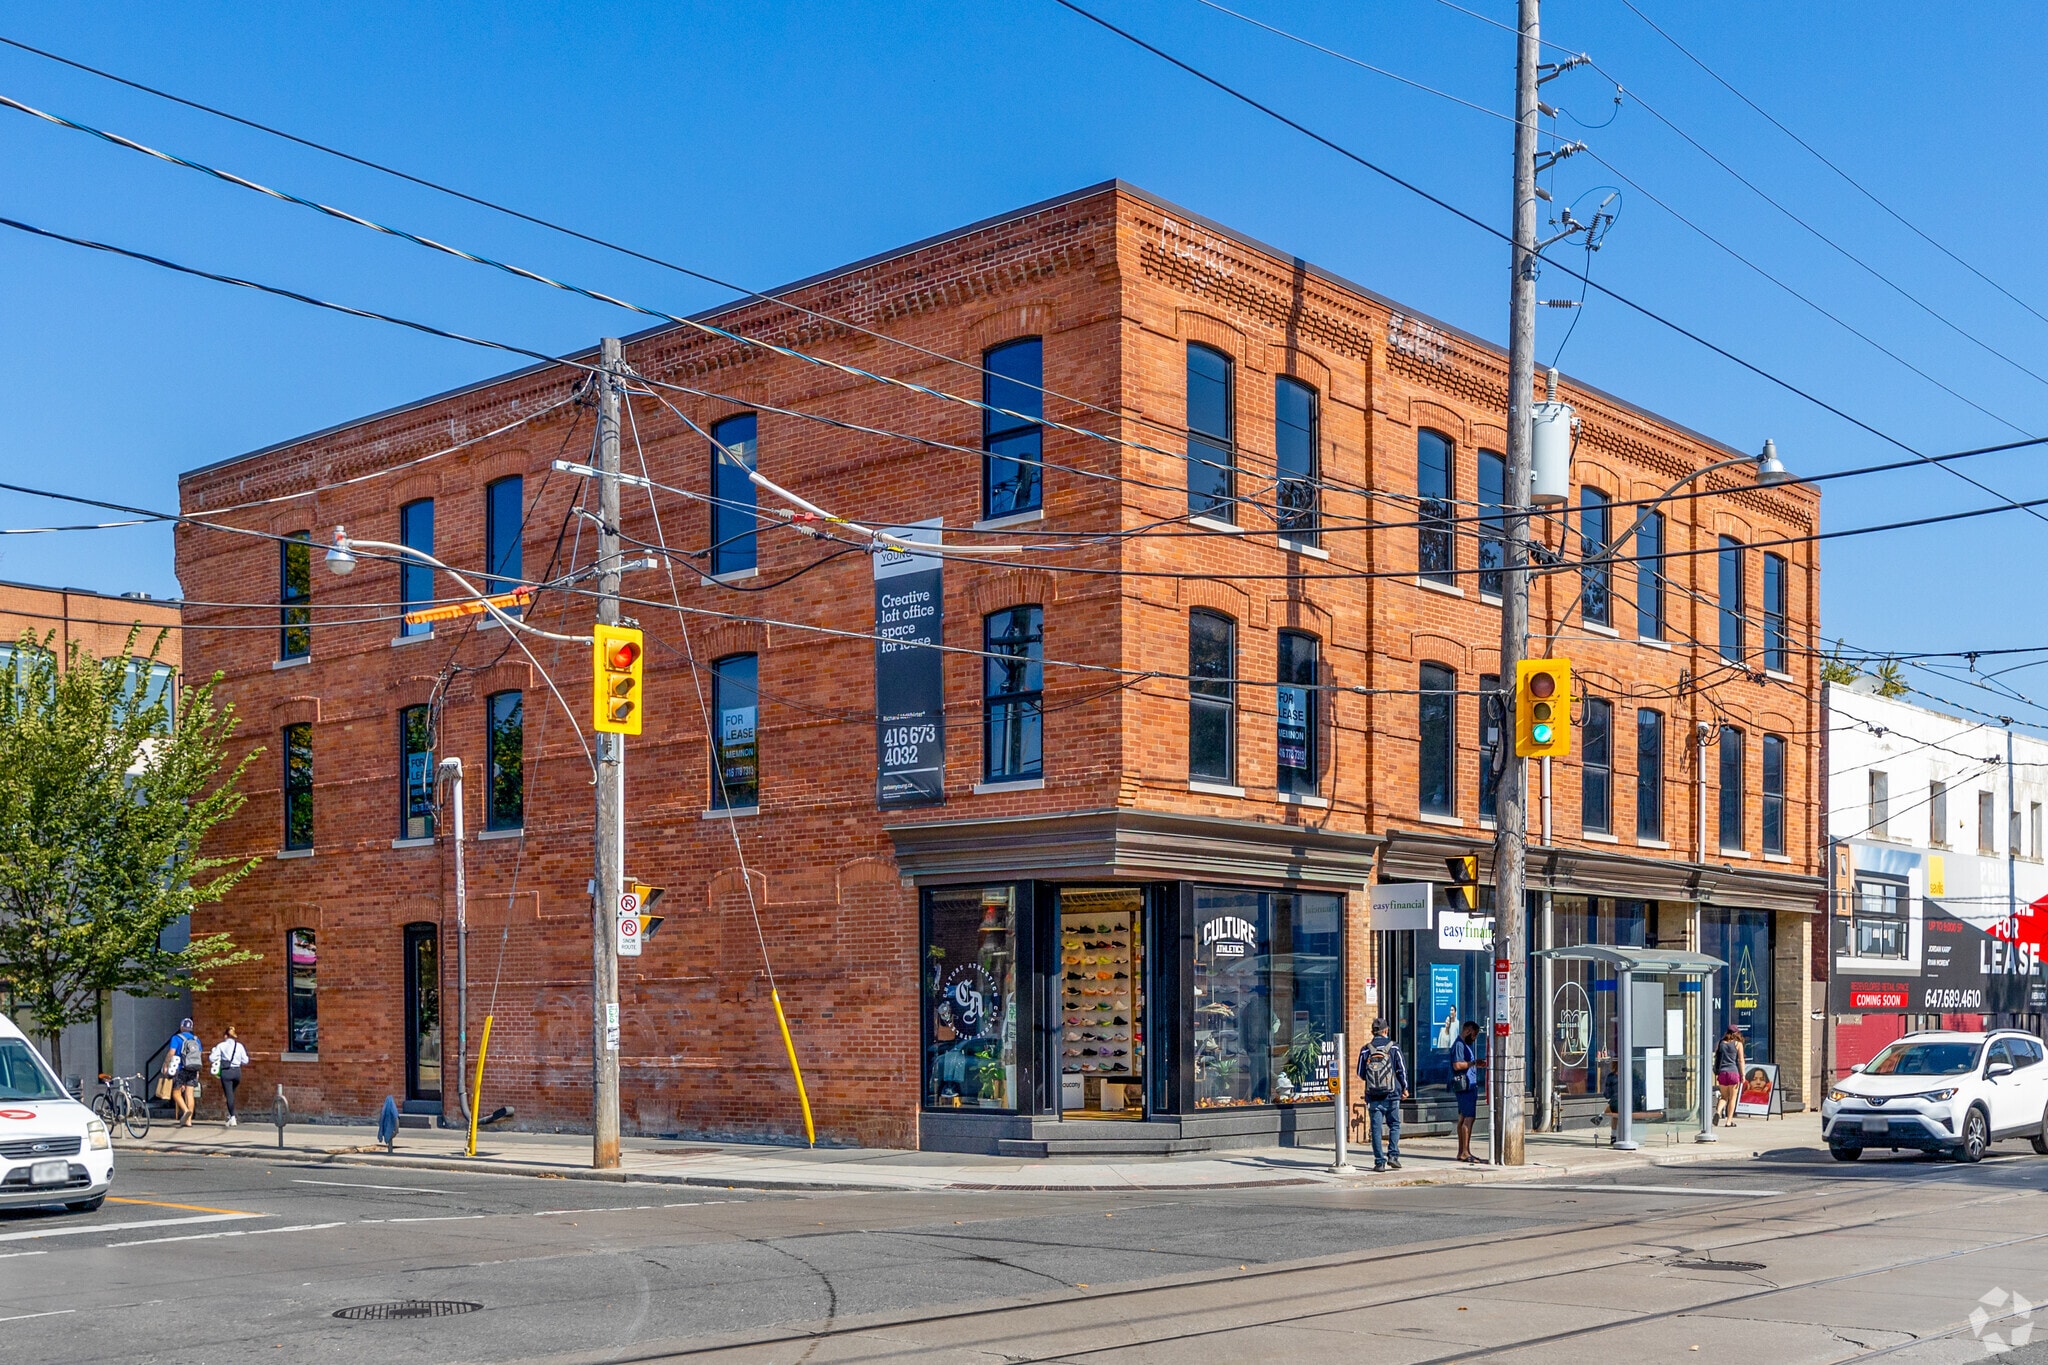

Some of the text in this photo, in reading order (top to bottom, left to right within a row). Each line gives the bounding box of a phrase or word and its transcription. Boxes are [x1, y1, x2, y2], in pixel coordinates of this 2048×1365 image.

[881, 590, 930, 608] Creative
[881, 604, 935, 624] loft office
[881, 623, 916, 639] space
[1278, 691, 1294, 704] FOR
[725, 715, 744, 726] FOR
[1278, 708, 1304, 720] LEASE
[725, 728, 754, 740] LEASE
[883, 724, 936, 747] 416 673
[884, 745, 918, 767] 4032
[1373, 899, 1425, 912] easyfinancial
[1203, 916, 1256, 949] CULTURE
[1443, 920, 1492, 939] easyfinan
[1995, 917, 2019, 939] FOR
[1216, 944, 1244, 954] ATHLETICS
[1980, 940, 2040, 975] LEASE
[1856, 994, 1902, 1006] COMING SOON
[1925, 988, 1981, 1008] 647.689.4610
[1317, 1054, 1335, 1066] YO
[1315, 1068, 1329, 1079] TRA
